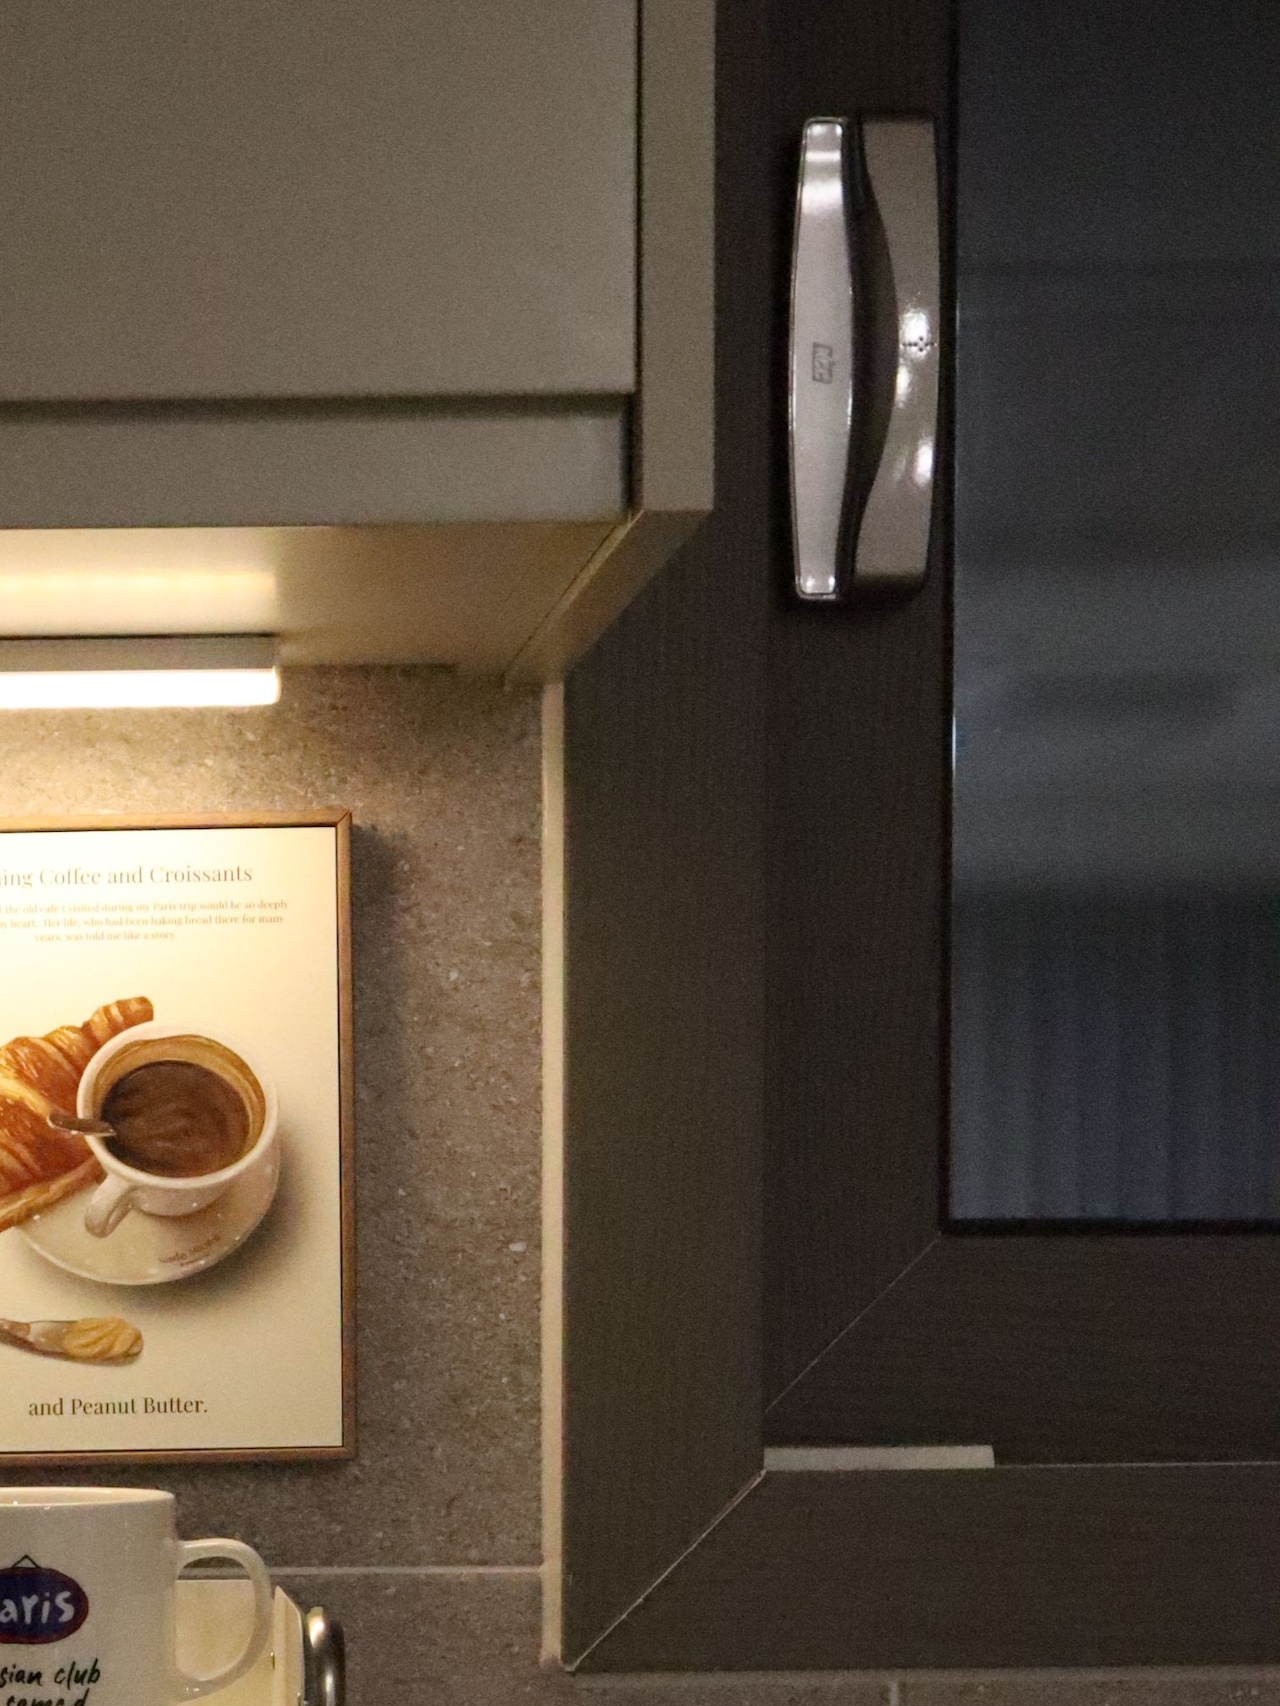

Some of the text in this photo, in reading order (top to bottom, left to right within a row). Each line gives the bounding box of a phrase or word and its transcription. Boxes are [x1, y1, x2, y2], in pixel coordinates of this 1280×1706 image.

[39, 866, 102, 886] Coffee
[107, 866, 144, 884] and
[150, 864, 254, 884] Croissants
[5, 904, 20, 914] the
[22, 904, 38, 914] old
[68, 902, 99, 913] visited
[101, 902, 134, 914] during
[136, 904, 150, 914] my
[153, 902, 177, 911] Paris
[179, 902, 197, 913] trip
[199, 901, 228, 910] would
[230, 901, 242, 910] be
[244, 902, 256, 910] so
[257, 899, 288, 911] deeply
[10, 919, 38, 929] heart.
[43, 919, 61, 928] Her
[83, 918, 103, 928] who
[105, 917, 123, 926] had
[125, 917, 149, 926] been
[150, 916, 183, 927] baking
[184, 915, 213, 925] bread
[214, 915, 240, 925] there
[242, 914, 256, 924] for
[258, 915, 284, 926] many
[86, 931, 105, 941] told
[107, 933, 121, 941] me
[124, 931, 141, 941] like
[28, 1395, 208, 1416] and Peanut Butter.
[52, 1657, 101, 1691] club
